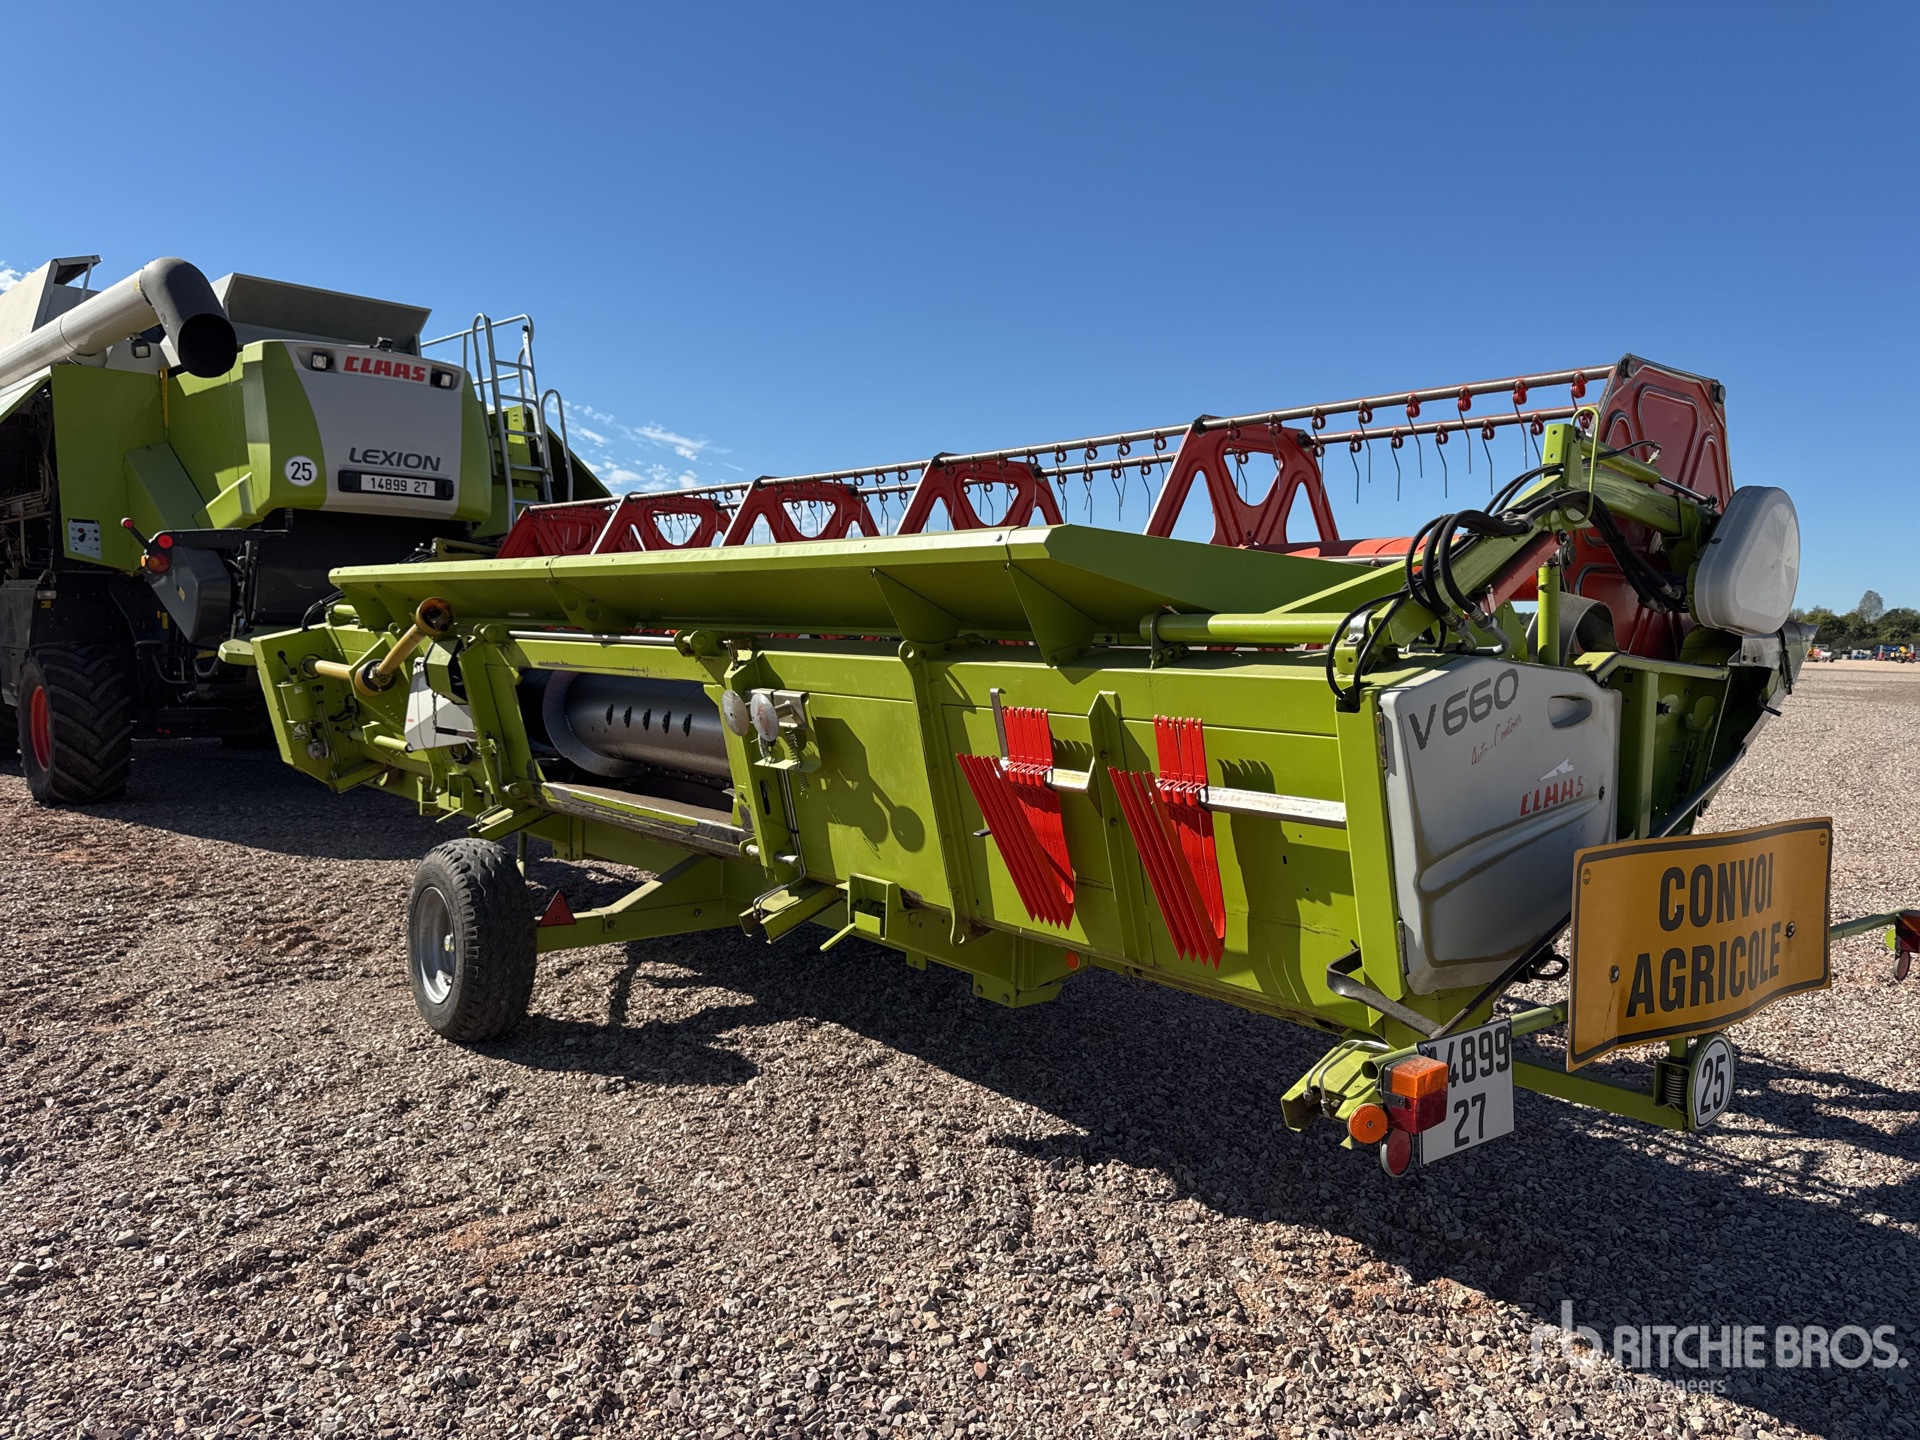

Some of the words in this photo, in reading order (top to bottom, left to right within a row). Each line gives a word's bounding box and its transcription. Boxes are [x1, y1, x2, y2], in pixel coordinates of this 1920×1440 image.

[344, 356, 426, 382] CLAAS
[290, 461, 313, 481] 25
[349, 447, 441, 472] LEXION
[370, 477, 407, 492] 14899
[414, 481, 428, 494] 27
[1659, 852, 1774, 932] CONVOI
[1626, 921, 1781, 1018] AGRICOLE
[1700, 1053, 1726, 1115] 25
[1454, 1092, 1486, 1148] 27
